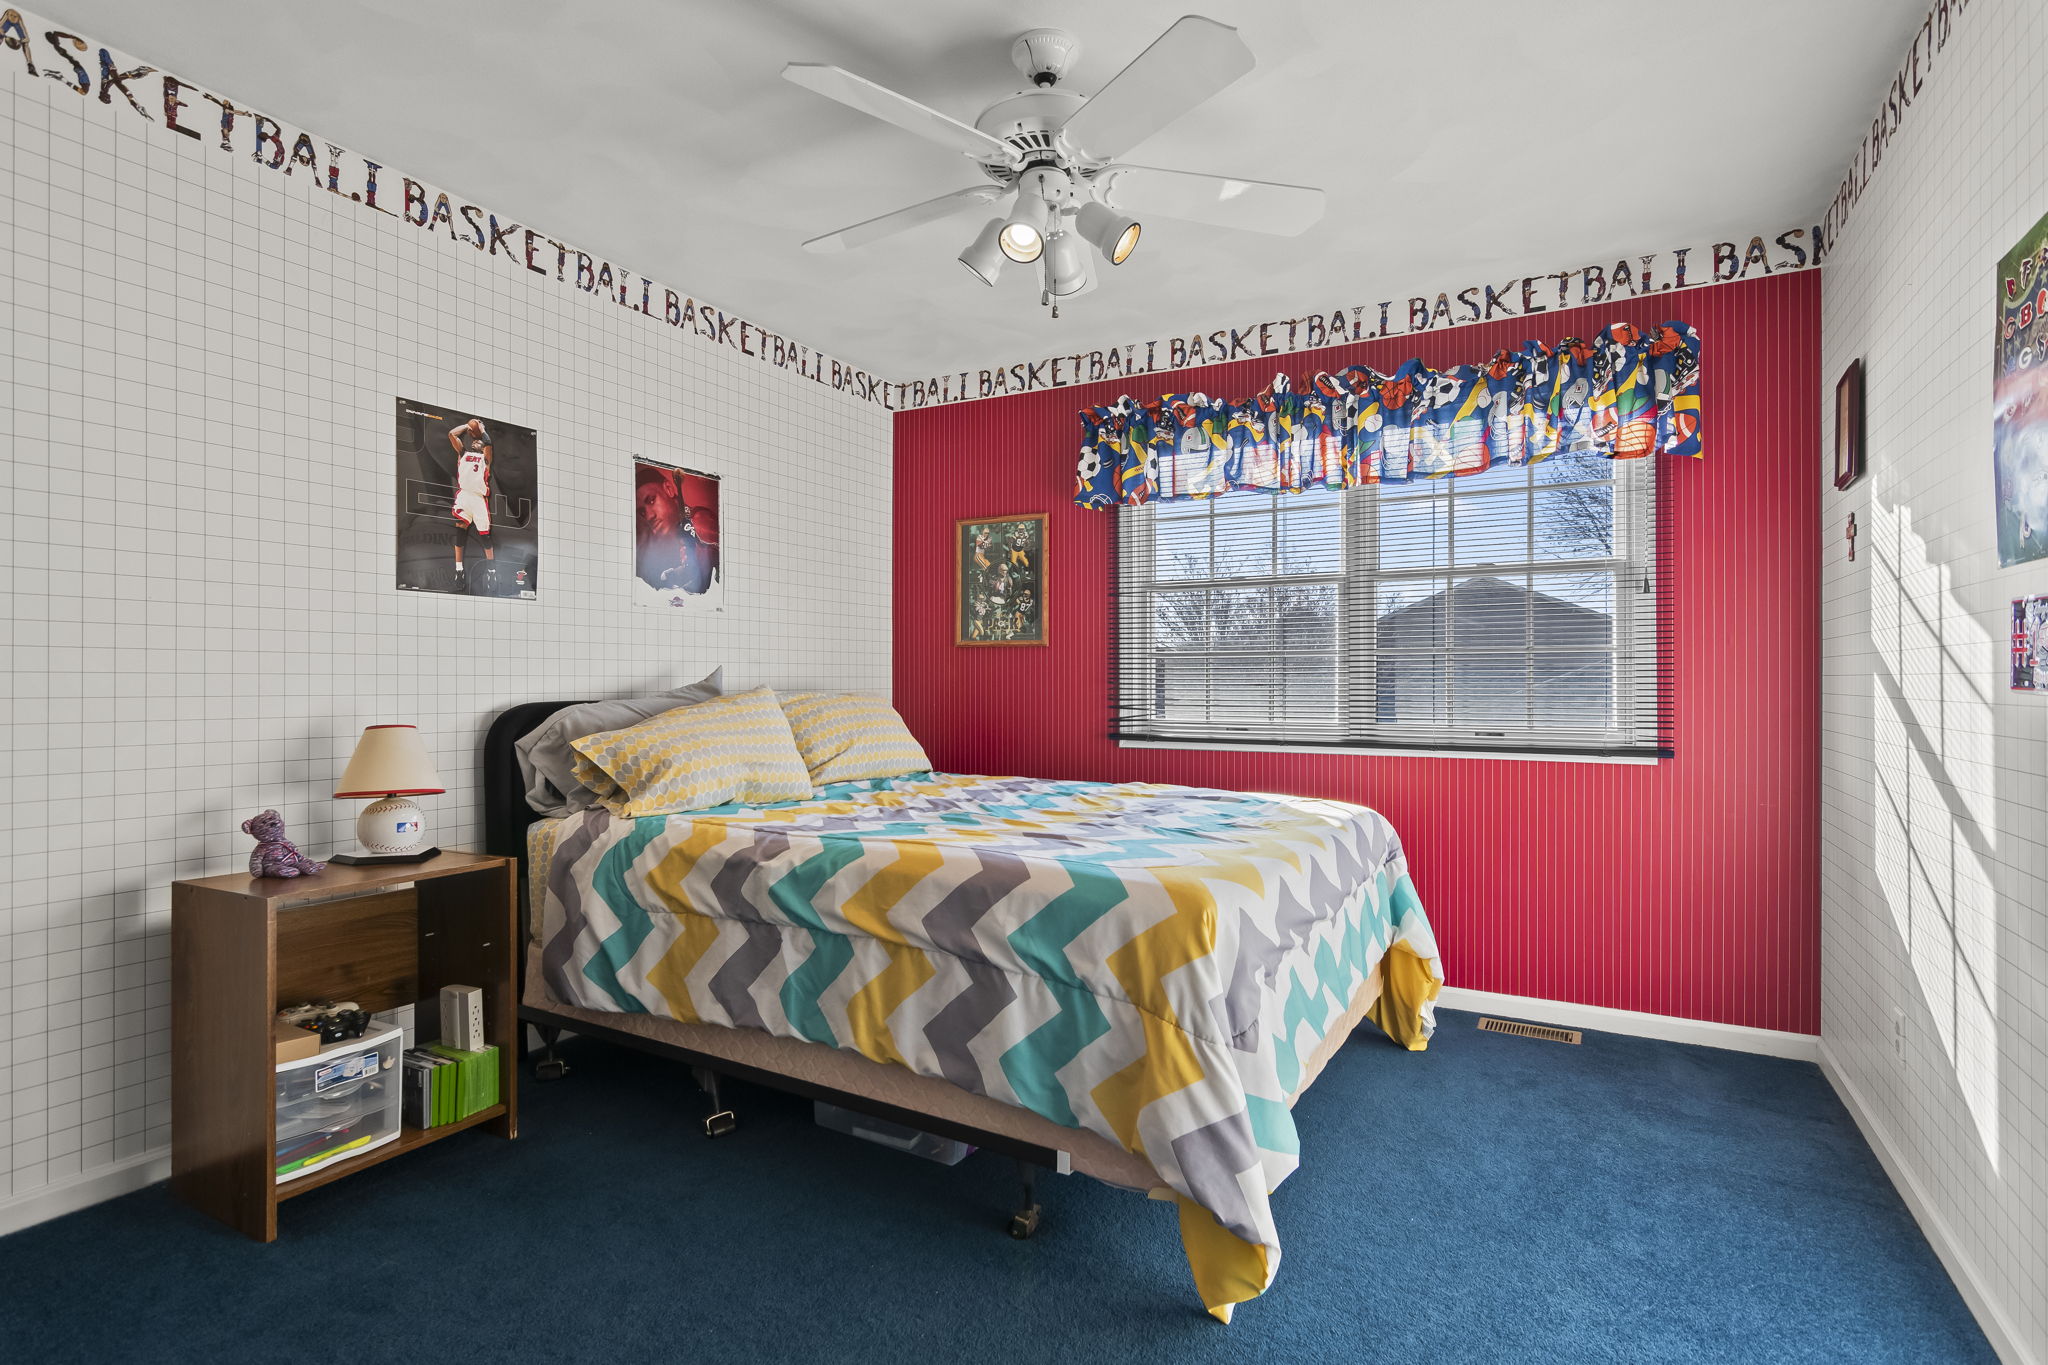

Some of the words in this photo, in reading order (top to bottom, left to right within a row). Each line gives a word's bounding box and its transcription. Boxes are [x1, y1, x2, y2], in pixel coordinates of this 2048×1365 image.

[403, 178, 662, 322] BASKETBALL
[665, 288, 830, 387] BASKETBALL
[979, 340, 1167, 398] BASKETBALL
[1169, 301, 1404, 367] BASKETBALL
[1408, 248, 1708, 333] BASKETBALL
[2019, 347, 2033, 369] G
[473, 464, 479, 472] 3
[1020, 602, 1032, 612] 87
